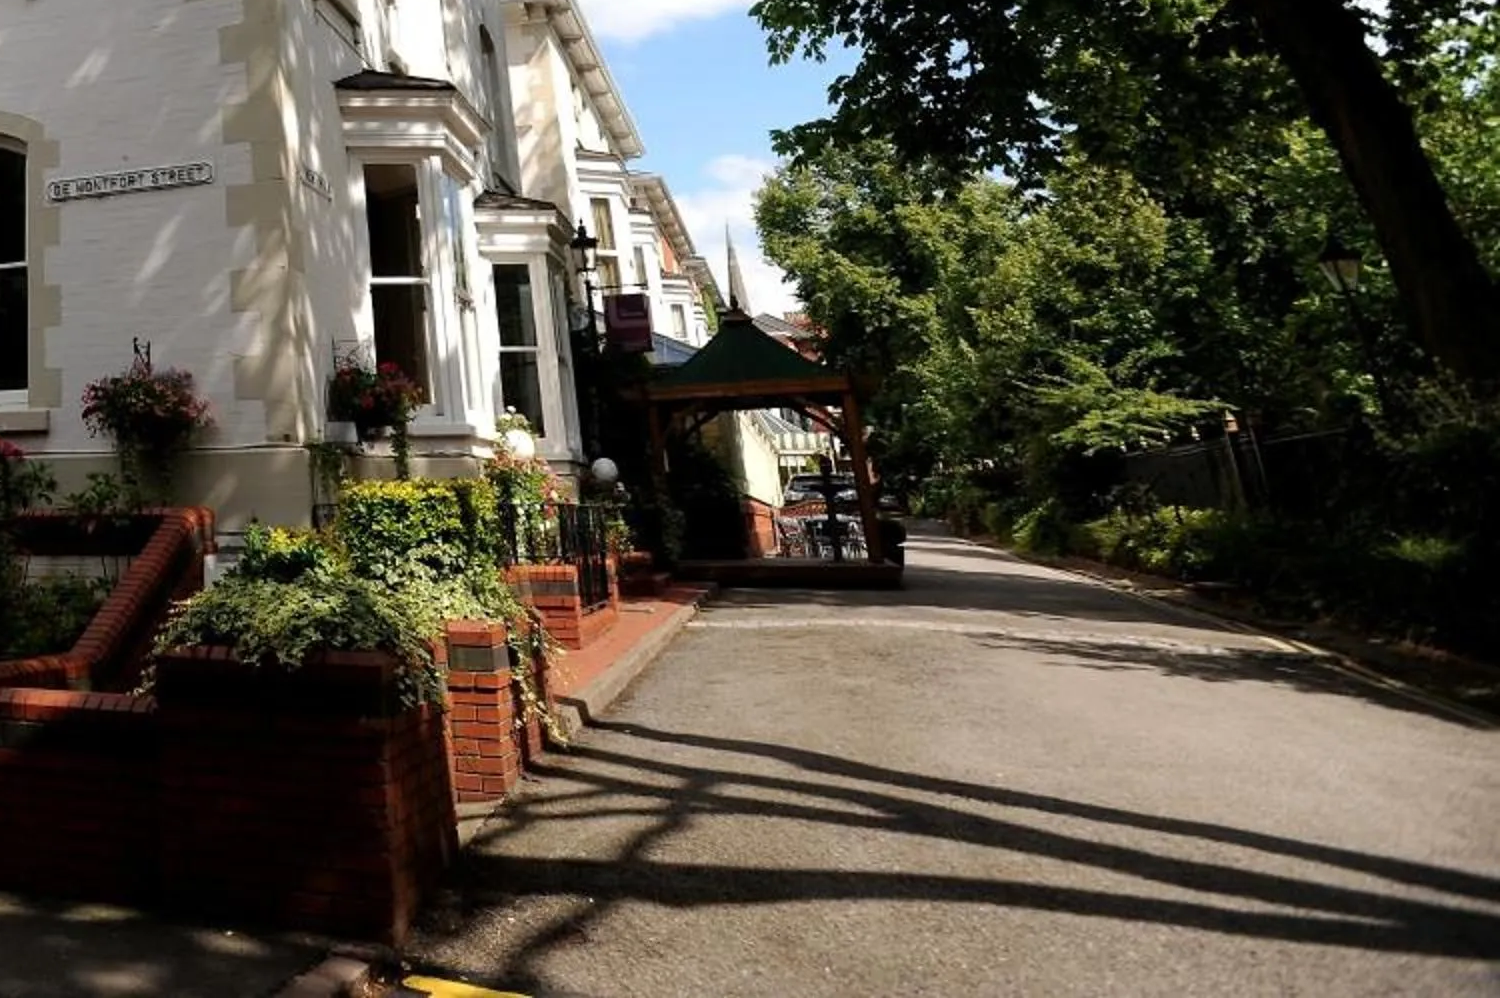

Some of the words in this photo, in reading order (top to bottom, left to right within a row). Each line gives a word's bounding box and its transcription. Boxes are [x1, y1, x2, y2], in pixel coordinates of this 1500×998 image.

[53, 182, 71, 196] DE
[75, 173, 145, 194] MONTFORT
[151, 165, 205, 185] STREET
